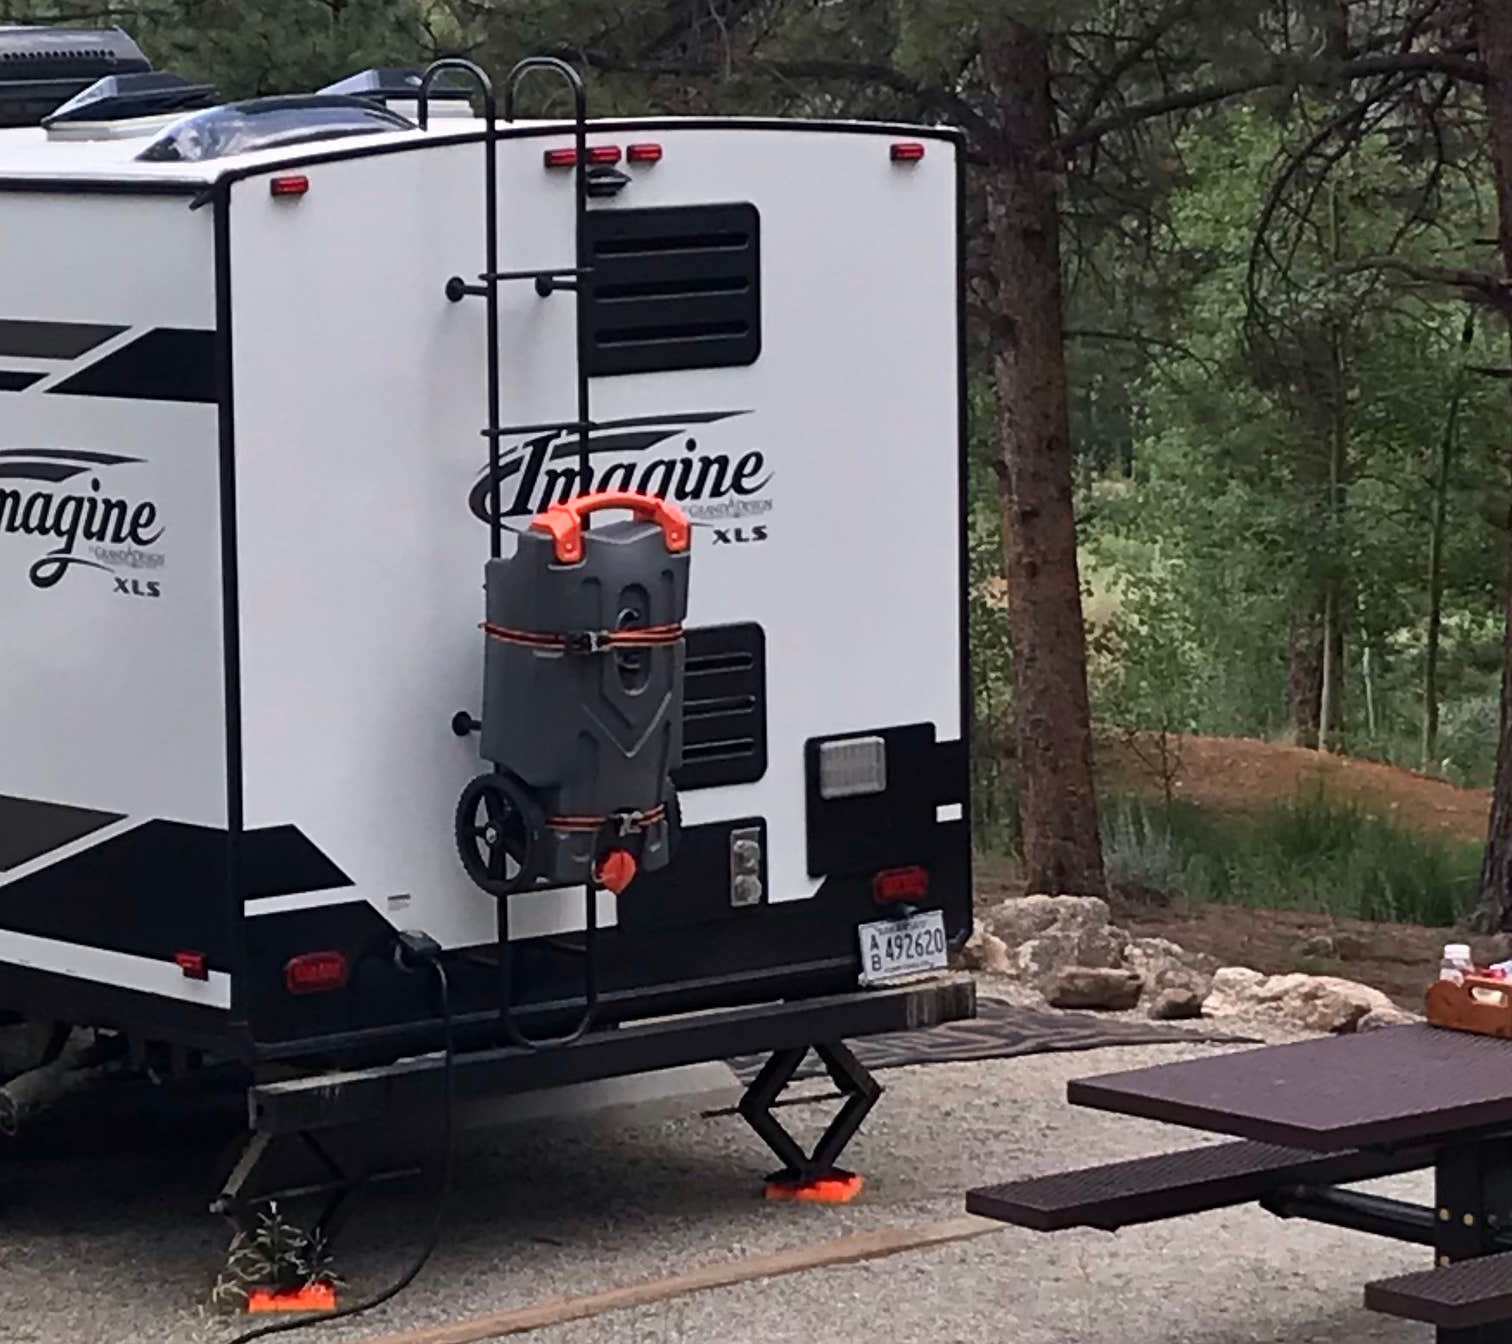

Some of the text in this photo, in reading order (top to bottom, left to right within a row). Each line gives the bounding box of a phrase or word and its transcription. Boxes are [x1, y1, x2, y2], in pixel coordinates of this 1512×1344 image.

[712, 525, 768, 545] XLS
[113, 577, 161, 597] XLS
[886, 928, 943, 960] 492620
